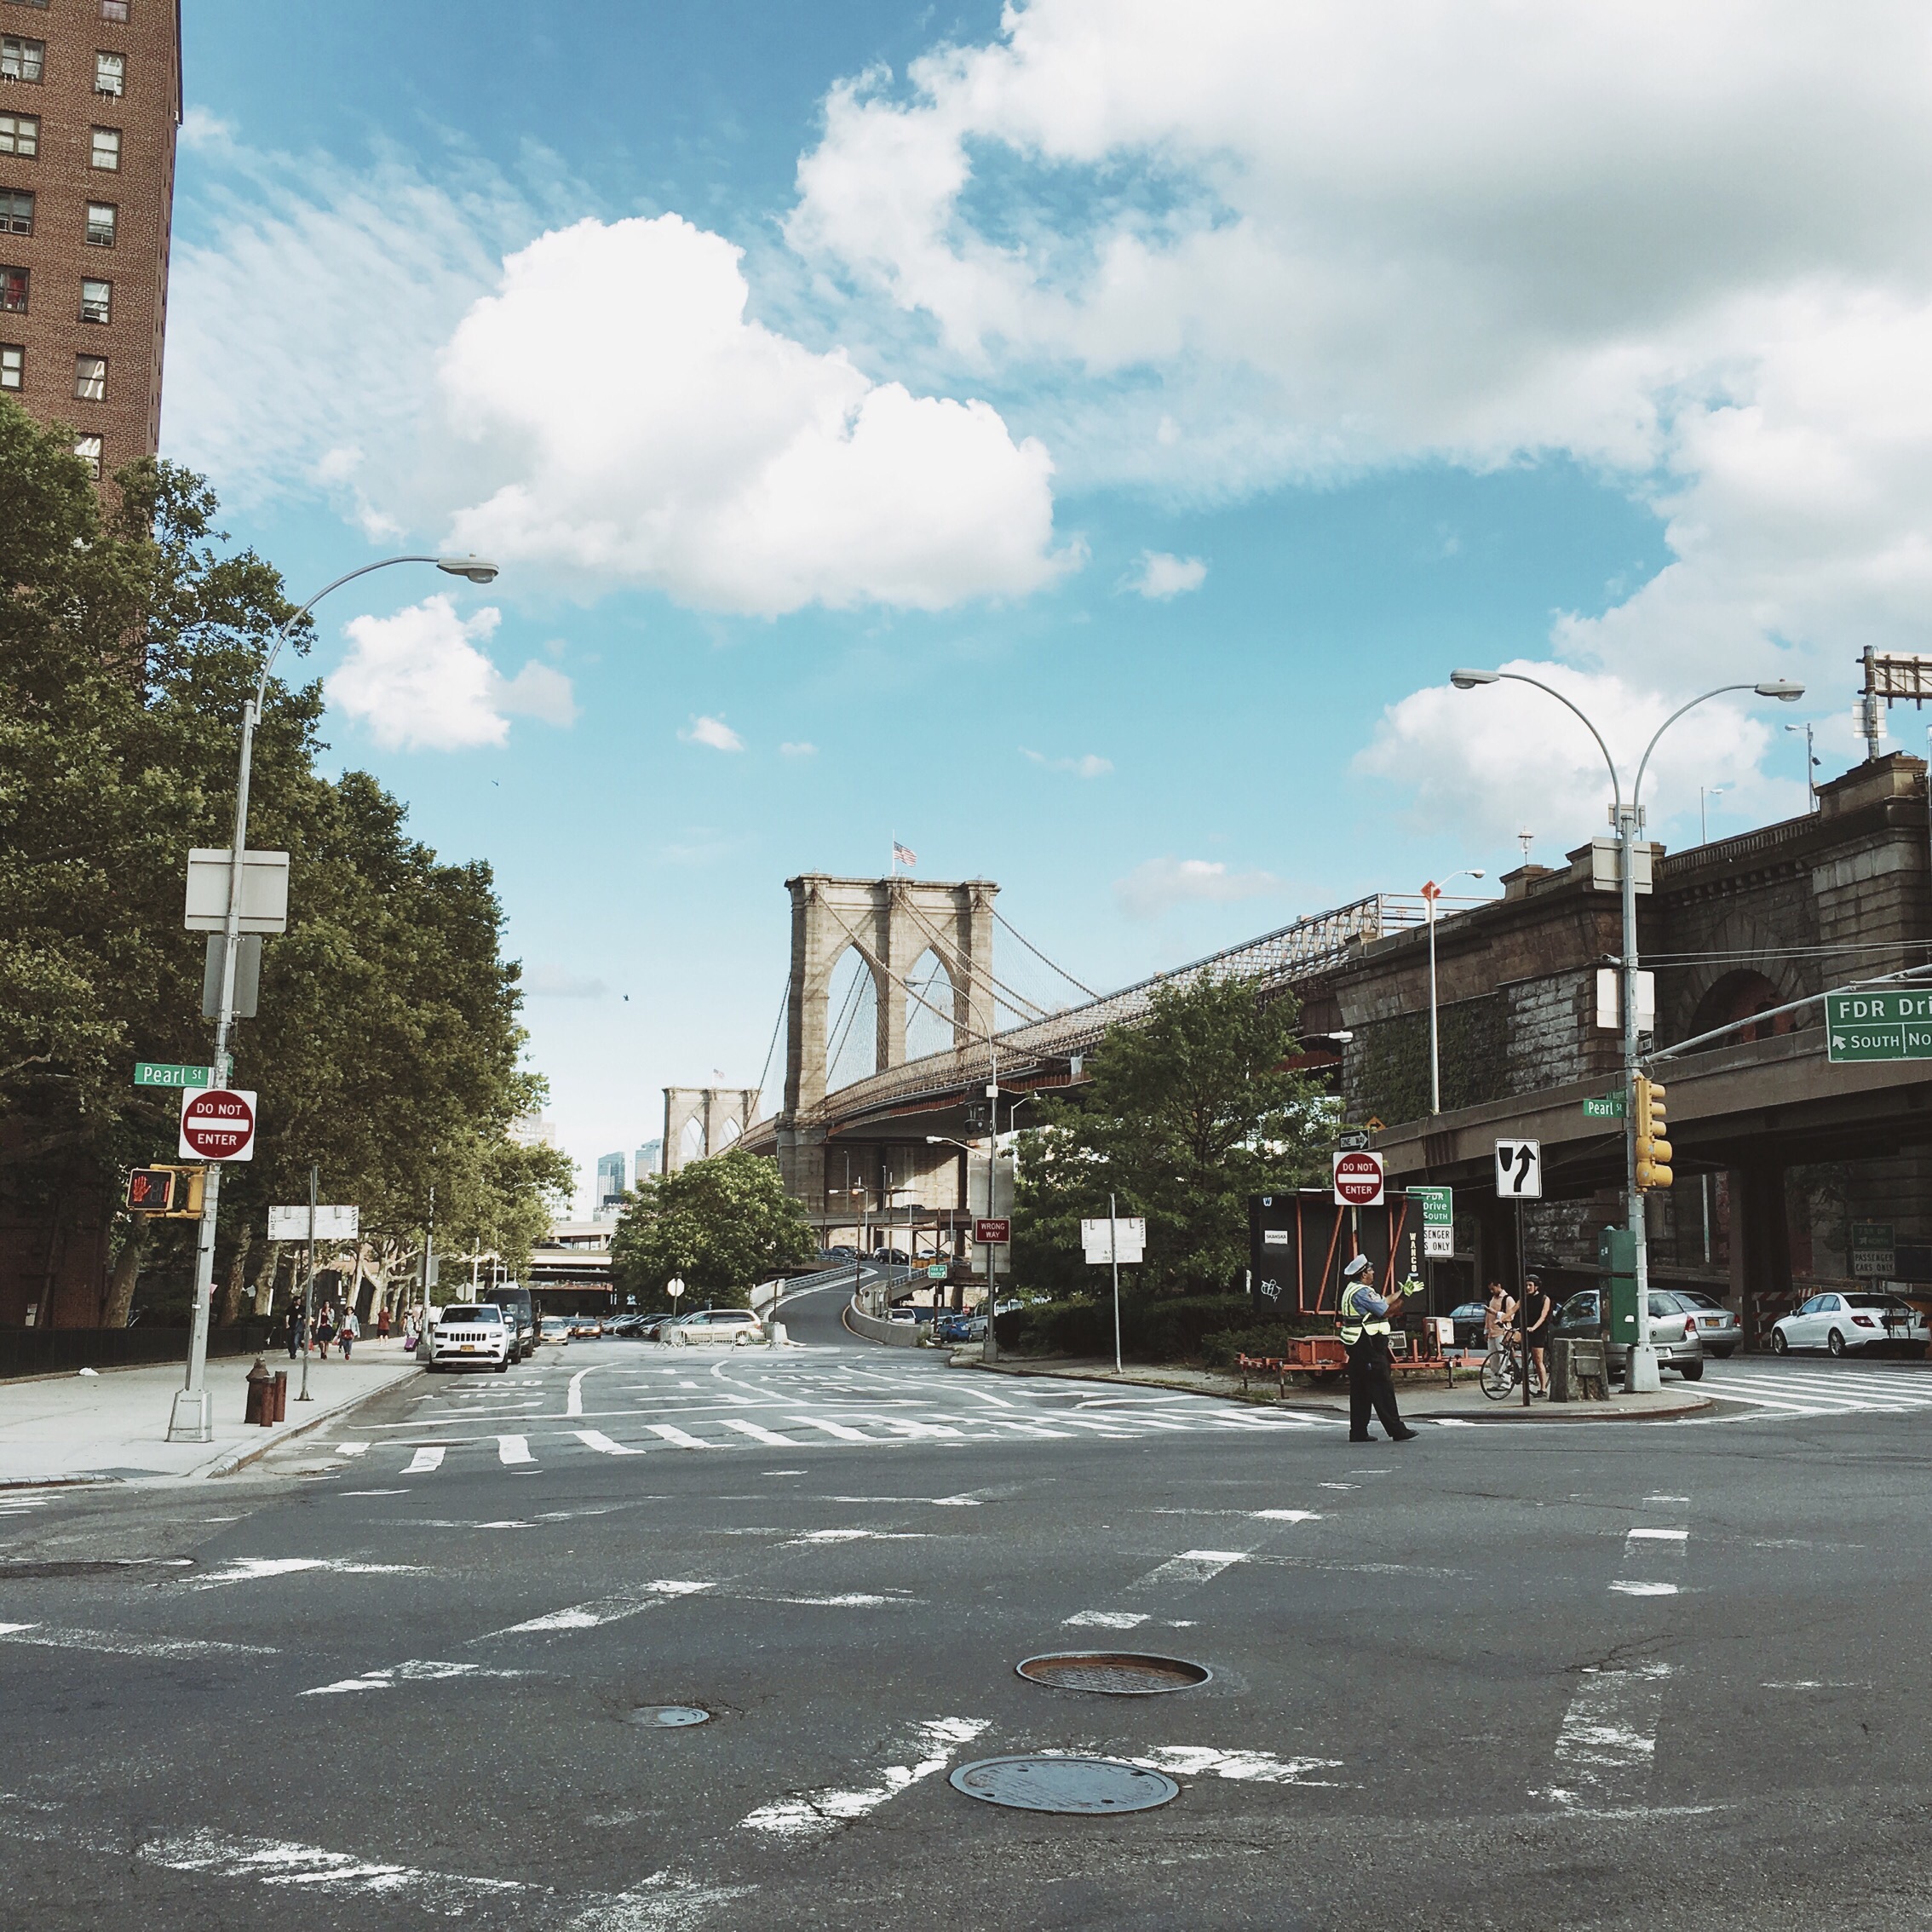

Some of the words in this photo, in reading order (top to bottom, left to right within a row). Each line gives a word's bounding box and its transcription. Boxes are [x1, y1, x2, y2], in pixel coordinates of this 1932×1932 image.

[1839, 1000, 1885, 1019] FDR
[1850, 1035, 1900, 1049] SOUTH
[1908, 1032, 1931, 1046] NO
[143, 1066, 185, 1084] Pearl
[192, 1069, 202, 1080] St
[196, 1102, 214, 1114] DO
[218, 1103, 243, 1115] NOT
[1588, 1101, 1613, 1115] Pearl
[1616, 1103, 1623, 1112] St
[197, 1133, 238, 1146] ENTER
[1341, 1137, 1351, 1147] ONE
[1343, 1163, 1354, 1171] DO
[1357, 1163, 1373, 1171] NOT
[1345, 1186, 1372, 1194] ENTER
[1423, 1202, 1447, 1210] Drive
[1409, 1232, 1417, 1273] WANCO
[1433, 1242, 1450, 1251] ONLY
